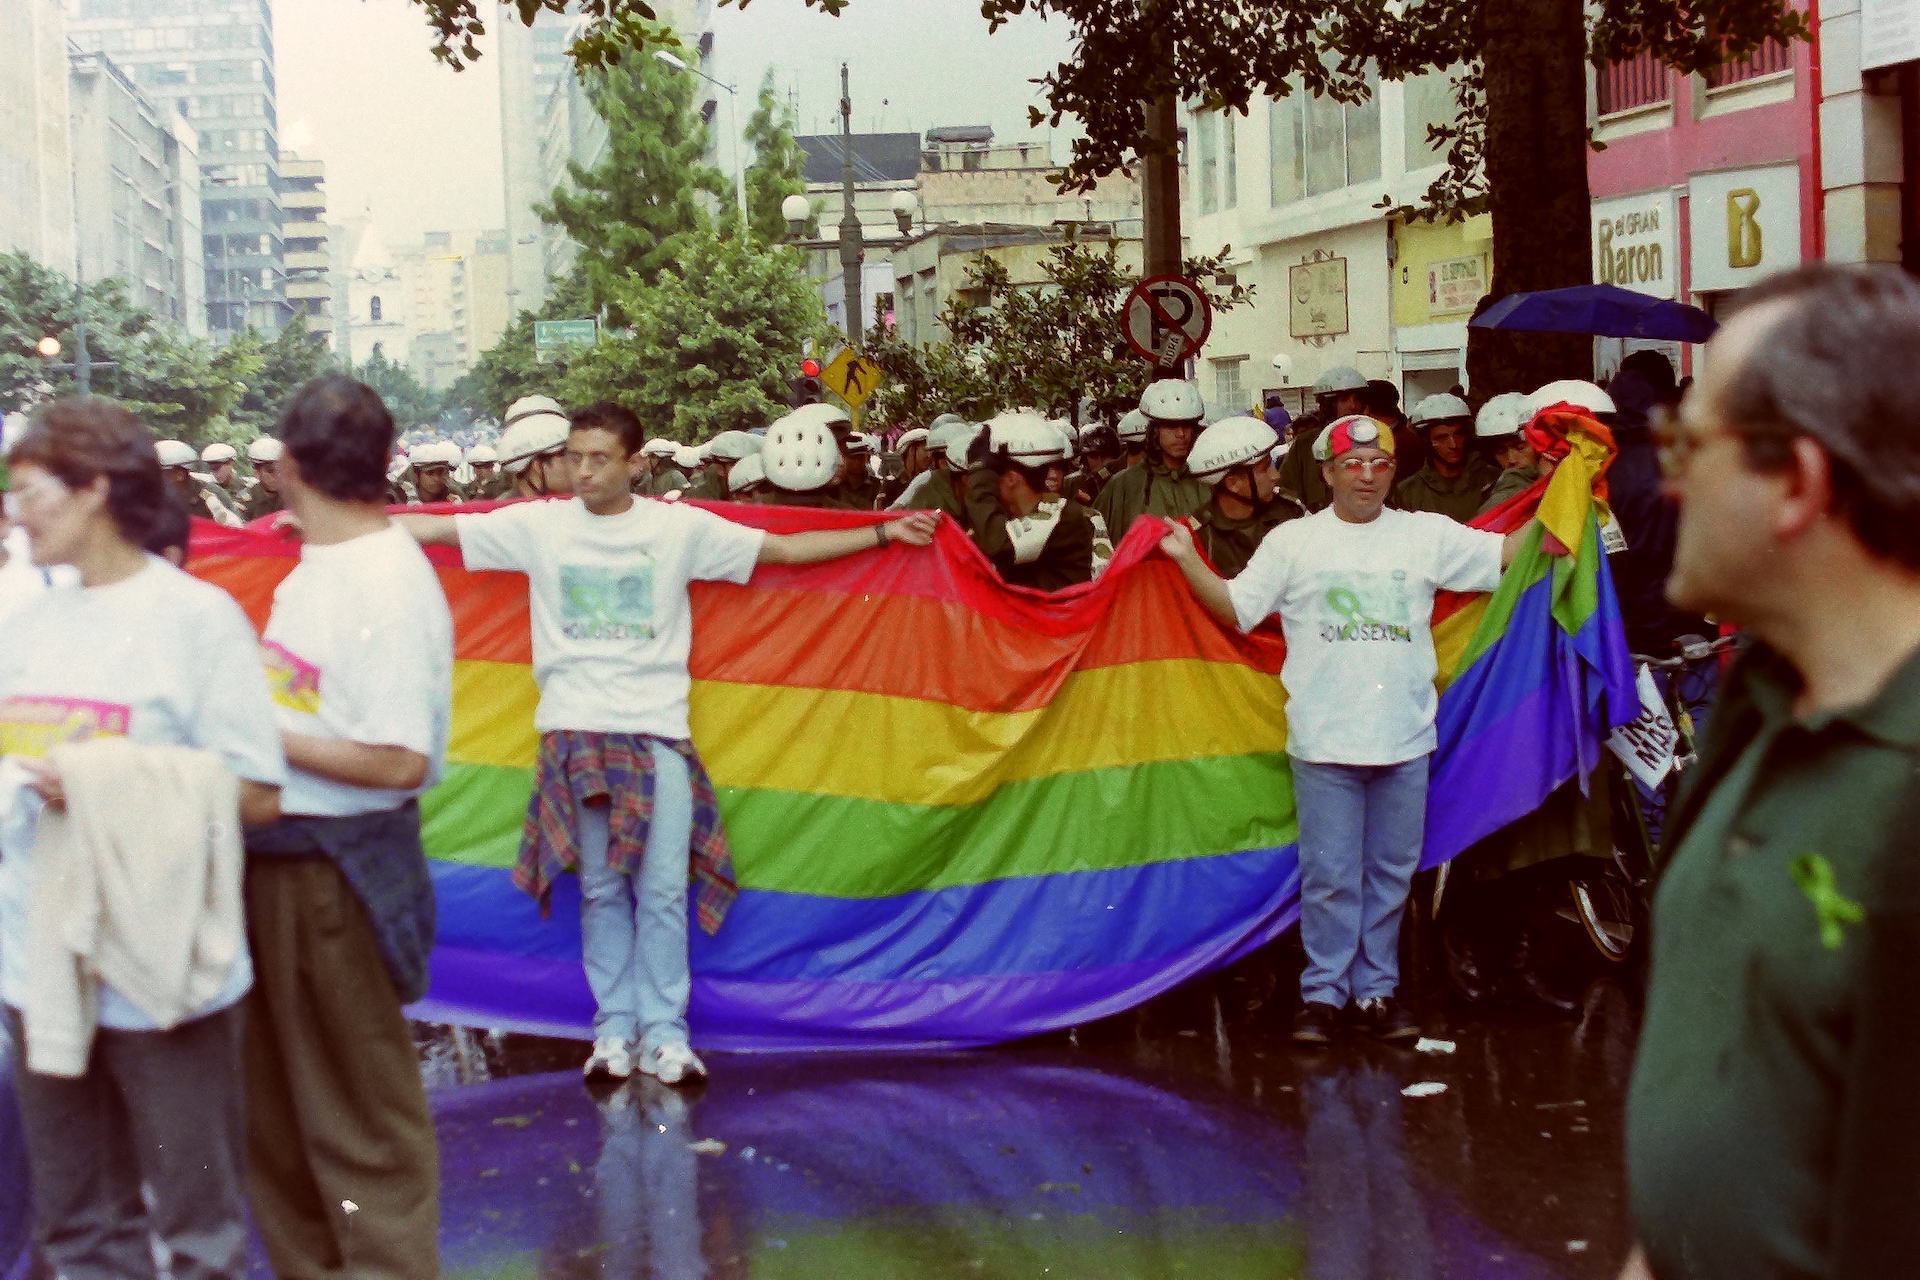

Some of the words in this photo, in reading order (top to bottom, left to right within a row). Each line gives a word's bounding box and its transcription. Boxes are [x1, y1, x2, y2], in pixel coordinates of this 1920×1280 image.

[1625, 207, 1660, 236] GRAN
[1726, 187, 1763, 268] B
[1151, 288, 1194, 350] P
